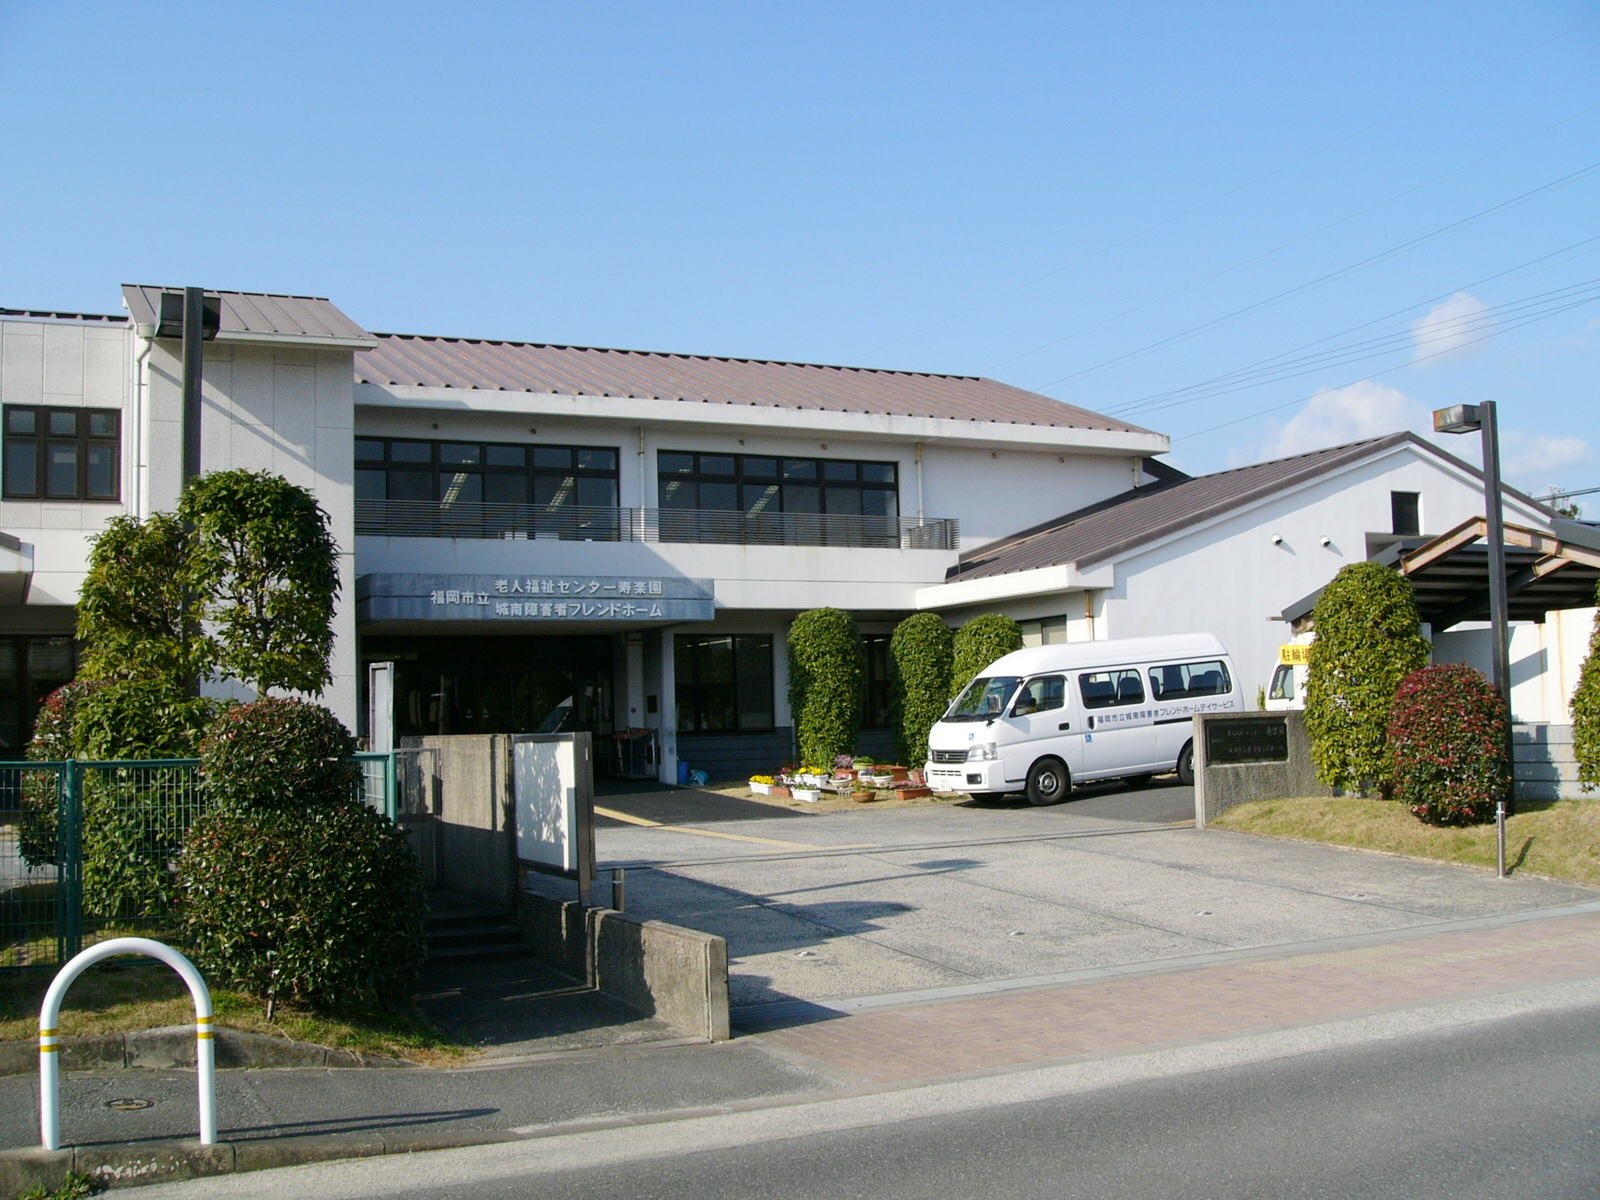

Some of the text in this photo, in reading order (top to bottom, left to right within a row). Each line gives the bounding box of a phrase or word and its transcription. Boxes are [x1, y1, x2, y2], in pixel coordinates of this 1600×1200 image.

[430, 590, 490, 605] 福岡市立
[495, 602, 663, 617] 城南障害者フレンドホーム
